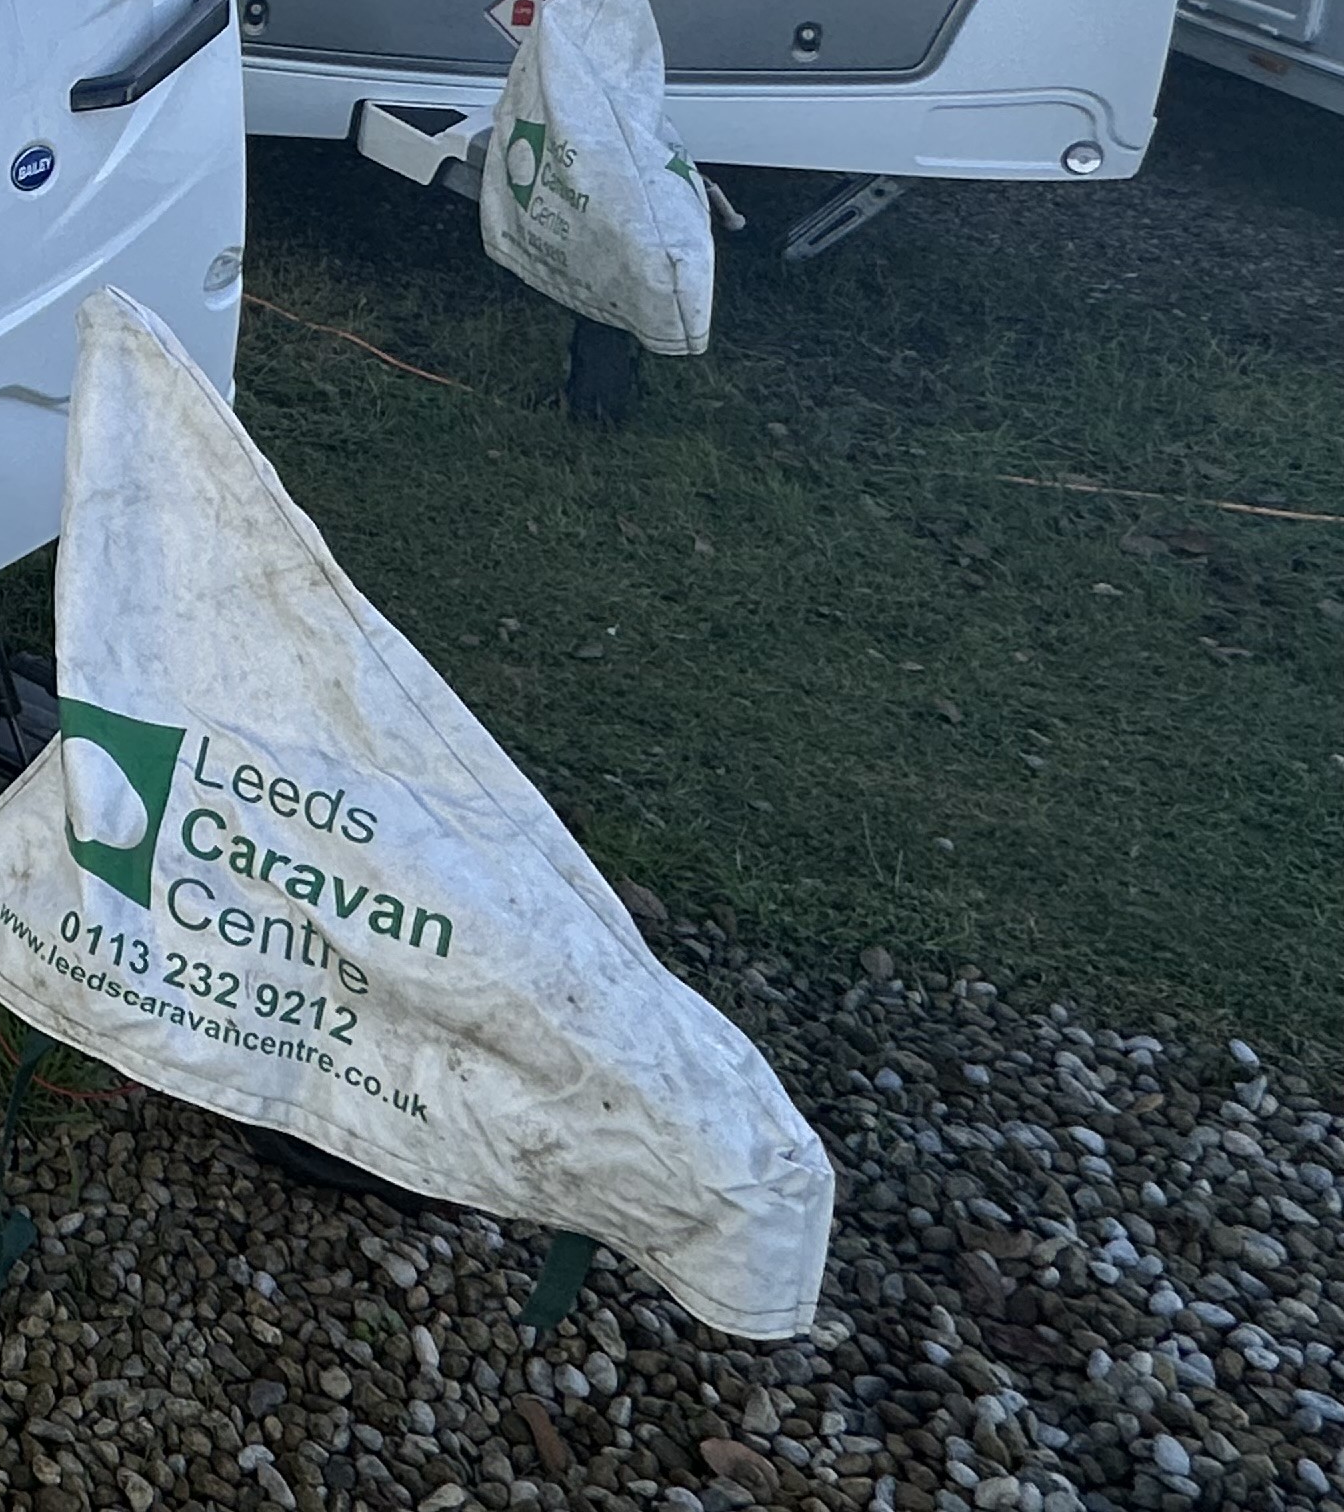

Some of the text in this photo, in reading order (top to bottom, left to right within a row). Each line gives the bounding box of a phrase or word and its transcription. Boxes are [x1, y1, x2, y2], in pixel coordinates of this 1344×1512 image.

[17, 154, 52, 182] BAILEY
[194, 735, 378, 844] Leeds
[167, 877, 370, 995] Centre
[180, 807, 454, 958] Caravan
[0, 903, 429, 1124] www.leedscaravancentre.co.uk
[60, 910, 359, 1046] 0113 232 9212
